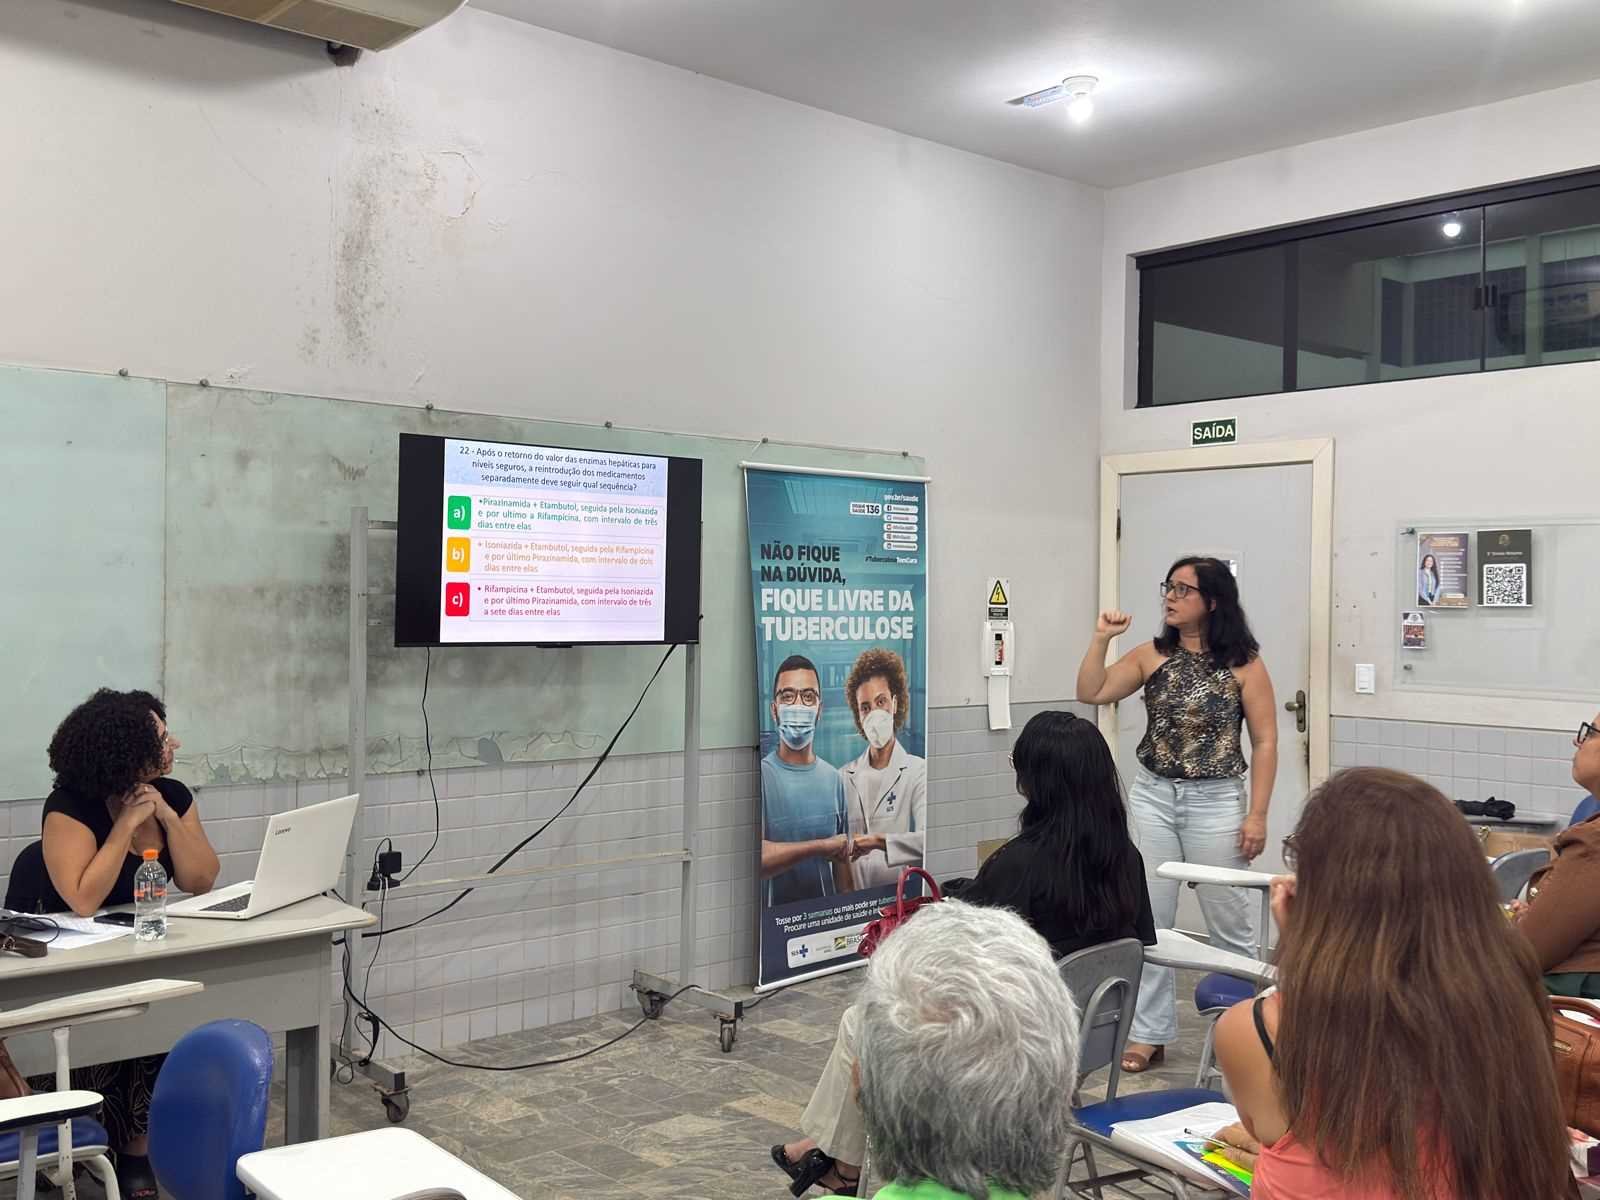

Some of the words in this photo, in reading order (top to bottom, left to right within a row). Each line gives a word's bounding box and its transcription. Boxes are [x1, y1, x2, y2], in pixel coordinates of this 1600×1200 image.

[1194, 422, 1234, 440] SAÍDA
[460, 446, 469, 455] 22
[476, 447, 496, 458] Após
[504, 451, 532, 460] retorno
[534, 453, 544, 461] do
[545, 454, 563, 462] valor
[565, 455, 577, 463] das
[579, 457, 607, 466] enzimas
[609, 458, 640, 469] hepáticas
[641, 462, 656, 470] para
[495, 462, 526, 473] seguros,
[534, 465, 581, 476] reintrodução
[582, 468, 595, 477] dos
[596, 470, 646, 480] medicamentos
[481, 474, 539, 485] separadamente
[540, 477, 558, 486] deve
[559, 479, 581, 488] seguir
[582, 481, 598, 490] qual
[599, 482, 637, 492] sequência?
[453, 505, 466, 521] a)
[540, 501, 579, 512] Etambutol,
[580, 504, 607, 513] seguida
[609, 505, 624, 514] pela
[866, 504, 880, 514] 136
[477, 520, 493, 529] dias
[494, 521, 515, 530] entre
[516, 522, 532, 531] elas
[486, 510, 500, 518] por
[583, 515, 598, 523] com
[601, 515, 631, 525] intervalo
[633, 517, 643, 525] de
[645, 518, 658, 526] três
[453, 547, 465, 563] b)
[491, 553, 505, 562] por
[629, 557, 639, 565] de
[760, 541, 794, 561] NÃO
[798, 545, 840, 562] FIQUE
[484, 562, 500, 572] dias
[501, 564, 522, 573] entre
[523, 564, 538, 573] elas
[761, 566, 783, 582] NA
[787, 563, 846, 586] DÚVIDA,
[484, 584, 528, 594] Rifampicina
[536, 585, 575, 596] Etambutol,
[577, 586, 603, 596] seguida
[604, 588, 619, 596] pela
[621, 587, 654, 597] Isoniazida
[452, 591, 463, 608] c)
[491, 597, 504, 606] por
[505, 596, 530, 606] último
[597, 597, 627, 607] intervalo
[761, 588, 824, 614] FIQUE
[827, 589, 884, 612] LIVRE
[888, 589, 914, 612] DA
[490, 608, 506, 616] sete
[508, 607, 524, 616] dias
[525, 608, 545, 616] entre
[546, 607, 561, 616] elas
[762, 616, 914, 641] TUBERCULOSE
[776, 916, 792, 926] Tosse
[792, 913, 802, 924] por
[833, 906, 841, 914] ou
[842, 903, 854, 912] mais
[784, 922, 807, 933] Procure
[807, 919, 820, 928] uma
[821, 914, 844, 926] unidade
[844, 912, 851, 920] de
